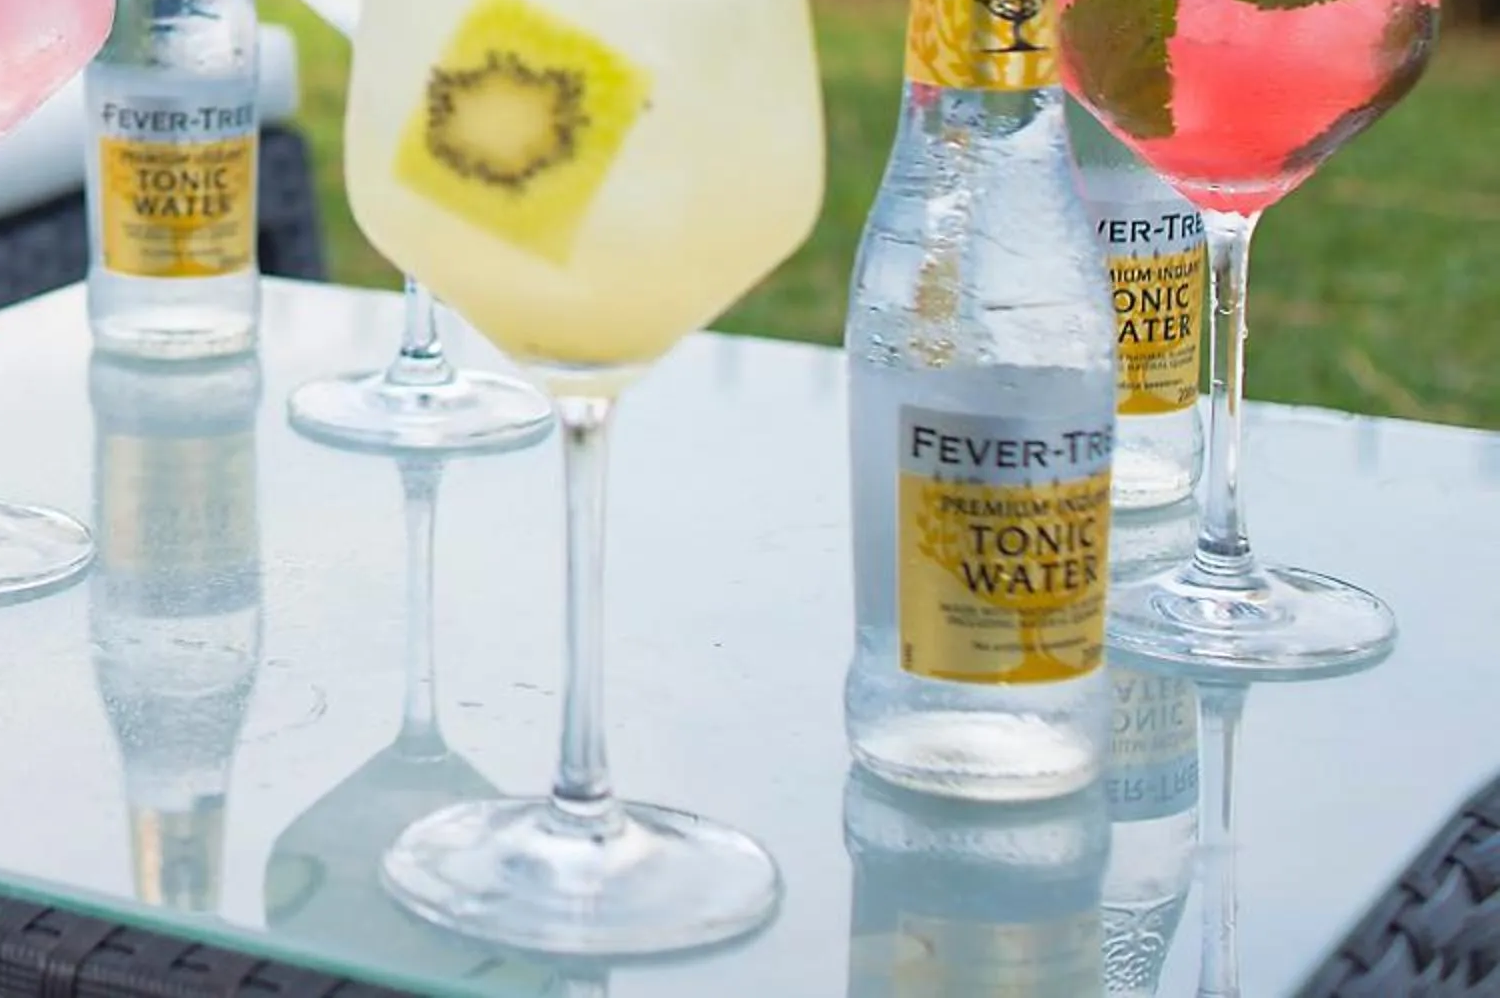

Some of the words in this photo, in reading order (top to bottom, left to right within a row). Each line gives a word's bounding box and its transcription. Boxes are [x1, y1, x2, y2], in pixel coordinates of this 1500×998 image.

[137, 167, 228, 192] TONIC
[133, 193, 232, 217] WATER
[1113, 283, 1189, 313] ONIC
[1118, 313, 1191, 344] ATER
[969, 517, 1097, 556] TONIC
[962, 555, 1099, 595] WATER
